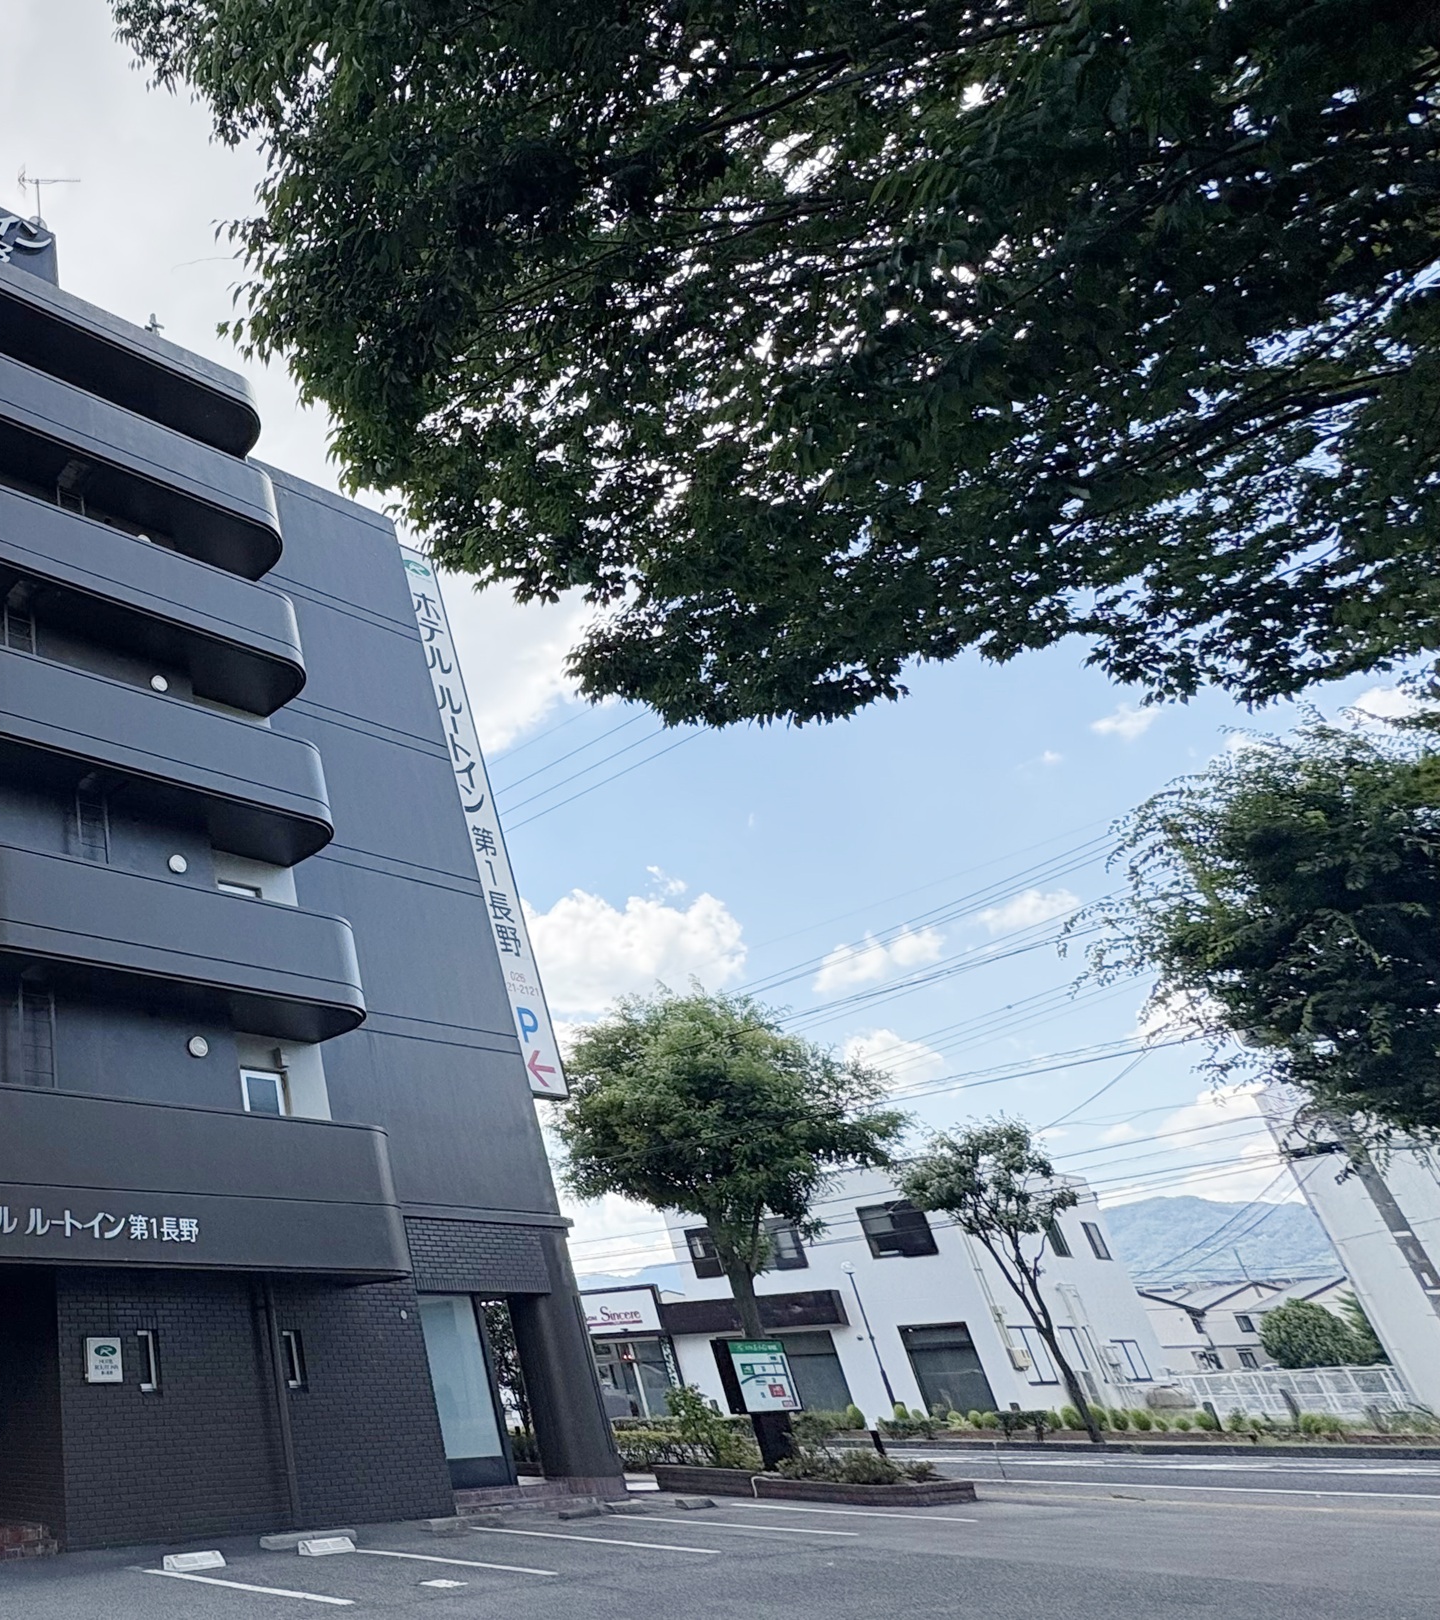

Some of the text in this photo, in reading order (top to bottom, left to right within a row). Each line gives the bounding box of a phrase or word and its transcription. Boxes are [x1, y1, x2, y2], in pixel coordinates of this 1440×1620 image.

[413, 592, 452, 674] ホテル
[438, 684, 484, 813] ルートイン
[516, 1007, 538, 1042] P
[24, 1208, 126, 1239] ルートイン
[128, 1214, 199, 1243] 第1長野
[600, 1306, 641, 1321] Sincere
